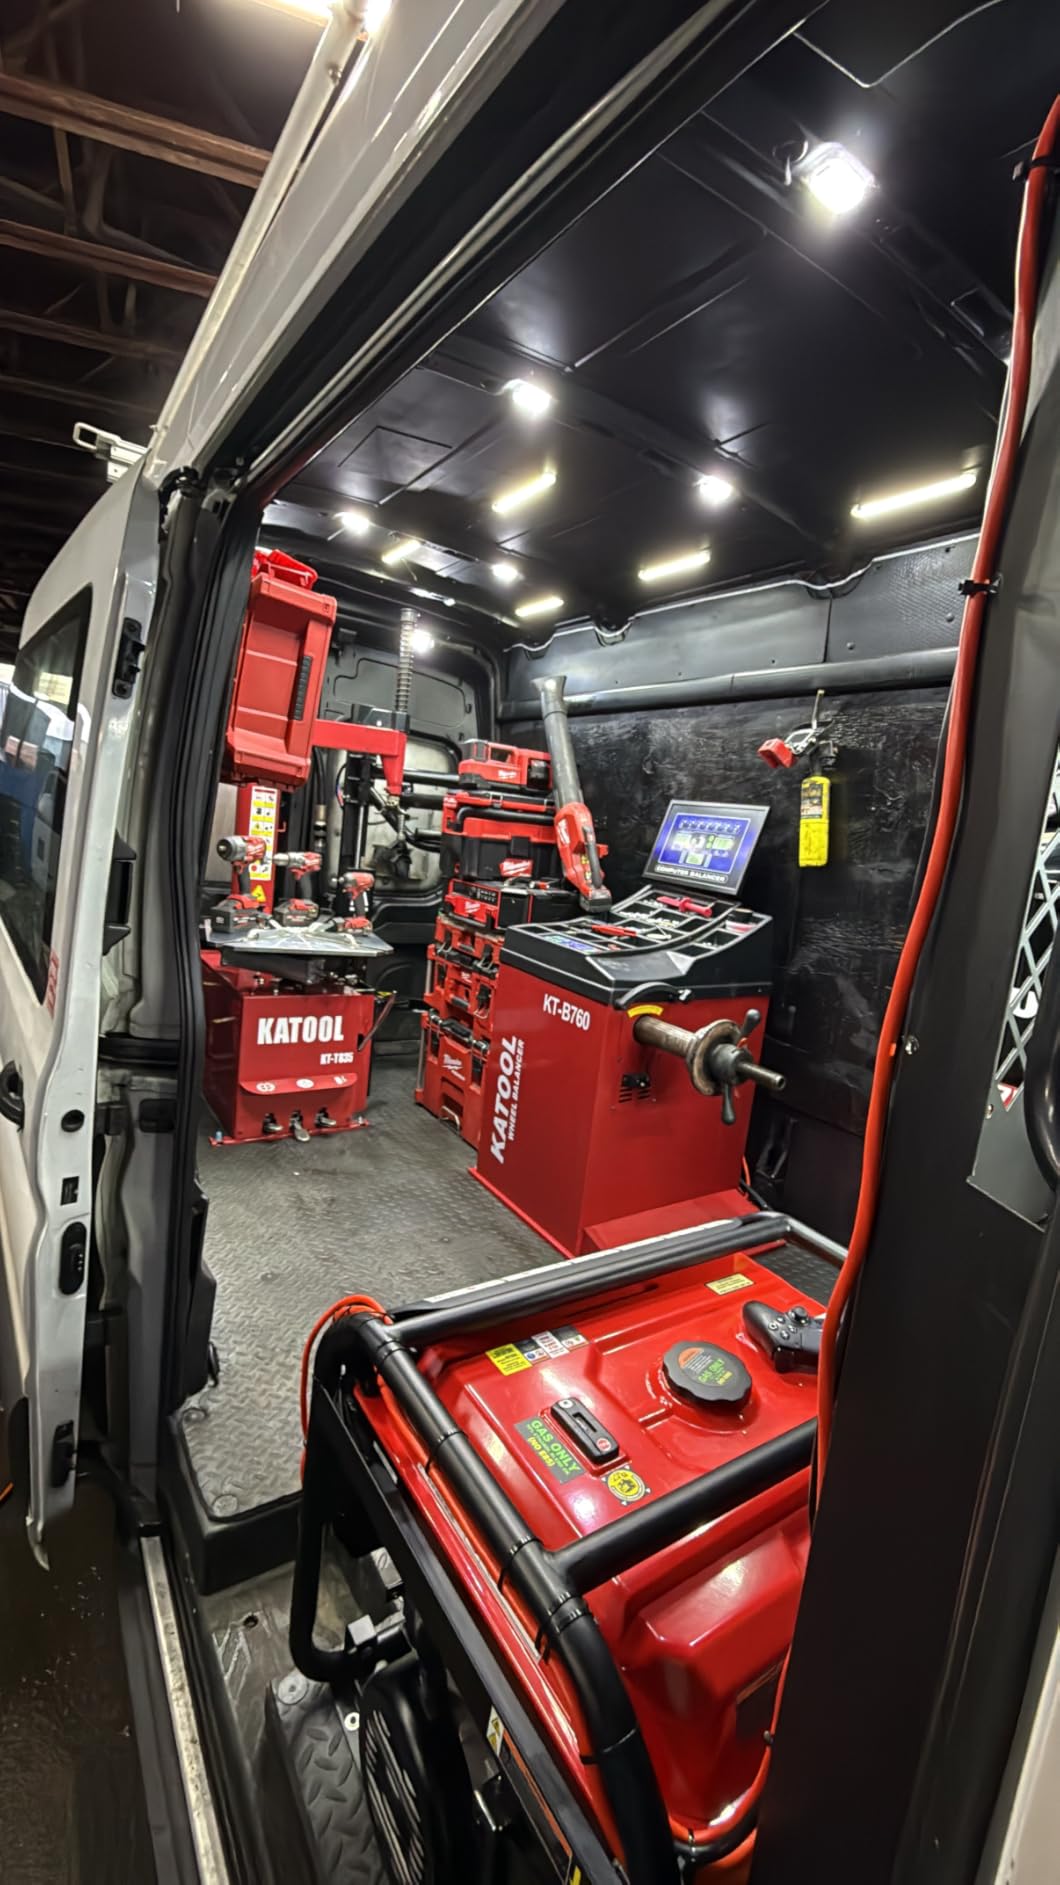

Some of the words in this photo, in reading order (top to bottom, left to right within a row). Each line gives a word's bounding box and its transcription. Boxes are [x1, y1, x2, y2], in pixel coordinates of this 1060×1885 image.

[689, 871, 726, 883] BALANCER
[256, 1015, 344, 1045] KATOOL
[543, 993, 591, 1031] KT-B760
[512, 1039, 525, 1101] BALANCER
[490, 1036, 518, 1164] KATOOL
[508, 1103, 518, 1141] WHEEL
[530, 1420, 554, 1442] GAS
[550, 1442, 581, 1472] ONLY
